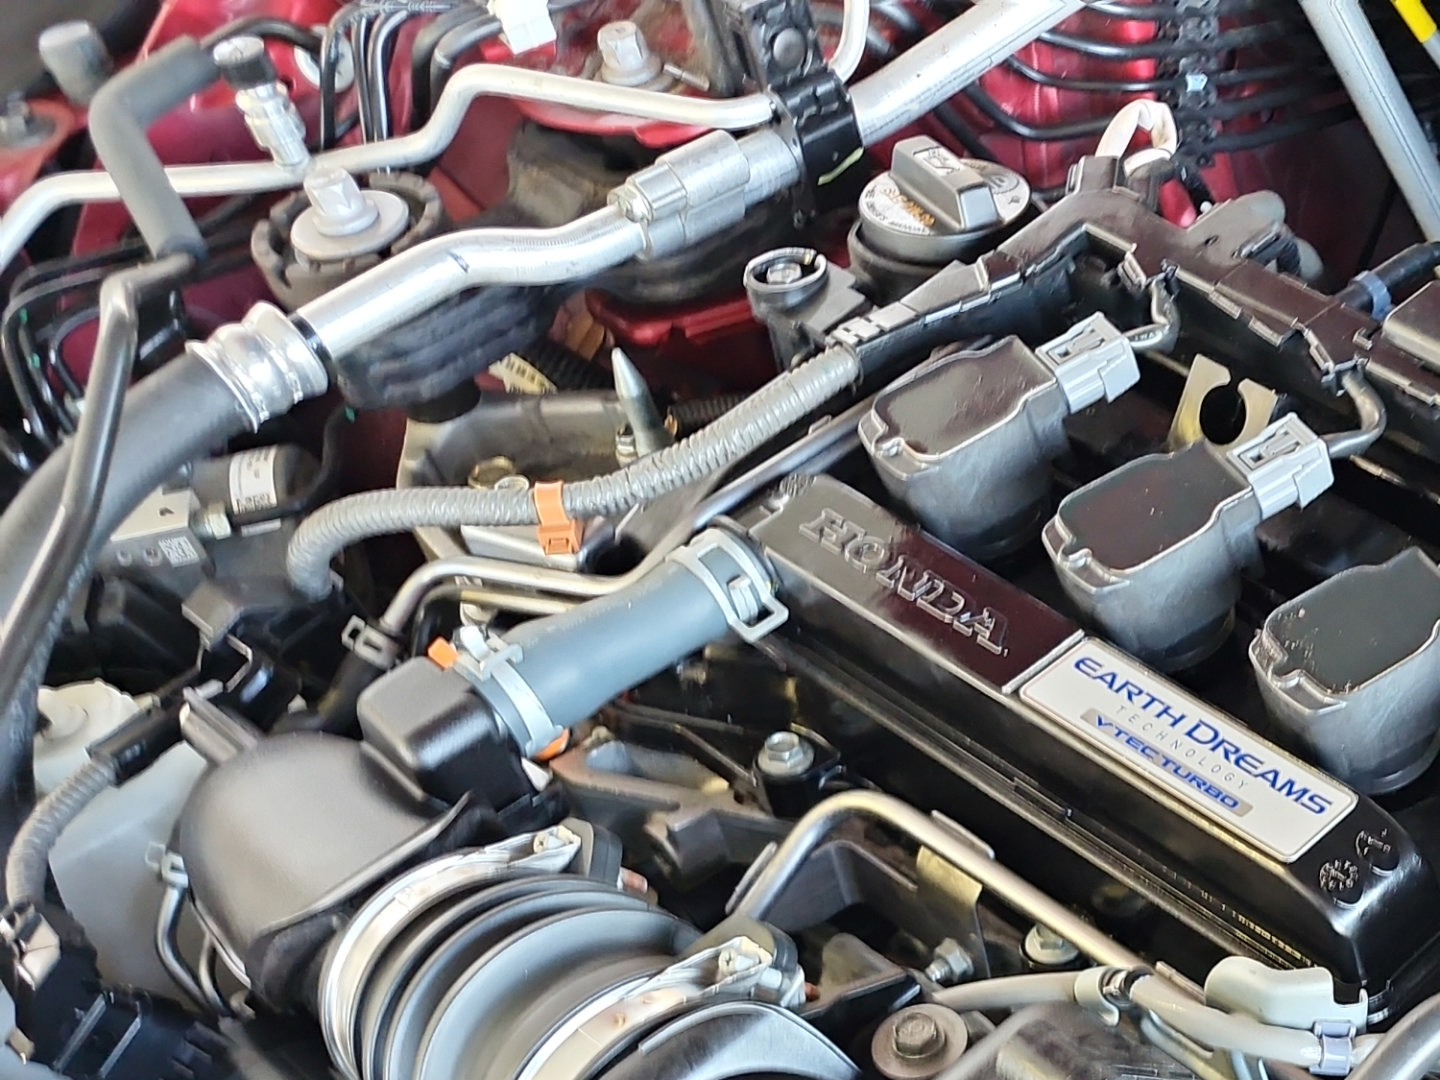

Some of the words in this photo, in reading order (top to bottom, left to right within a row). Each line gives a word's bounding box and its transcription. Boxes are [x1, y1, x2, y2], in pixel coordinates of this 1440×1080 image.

[800, 508, 1005, 655] HONDA
[1073, 656, 1185, 729] EARTH
[1185, 721, 1333, 815] DREAMS
[1116, 705, 1249, 790] TECHNOLOGY
